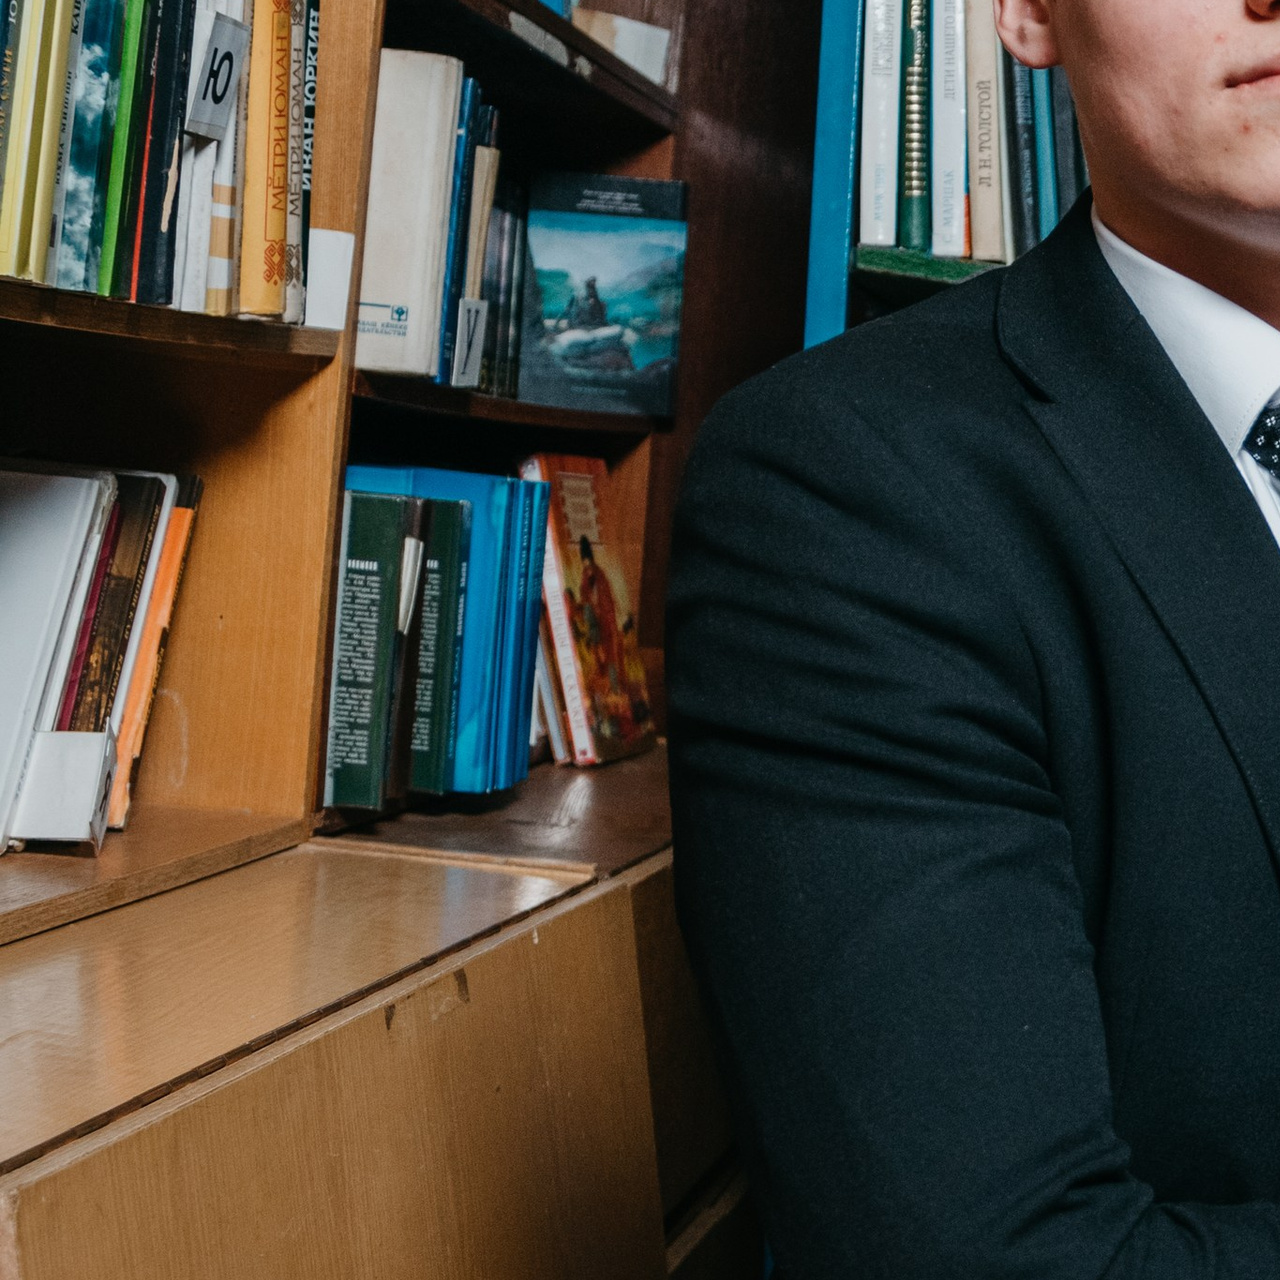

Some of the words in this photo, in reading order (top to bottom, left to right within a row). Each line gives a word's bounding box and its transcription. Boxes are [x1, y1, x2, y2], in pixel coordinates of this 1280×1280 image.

[303, 7, 321, 107] ЮРКИН
[944, 15, 957, 66] НАШЕГО
[201, 47, 234, 105] Ю
[273, 35, 288, 118] ЮМАН
[290, 47, 303, 128] ЮМАН
[944, 68, 957, 101] ДЕТИ
[976, 80, 992, 152] ТОЛСТОЙ
[55, 142, 66, 185] ЮХМА
[301, 116, 315, 191] ИВАН
[942, 170, 955, 226] МАРШАК
